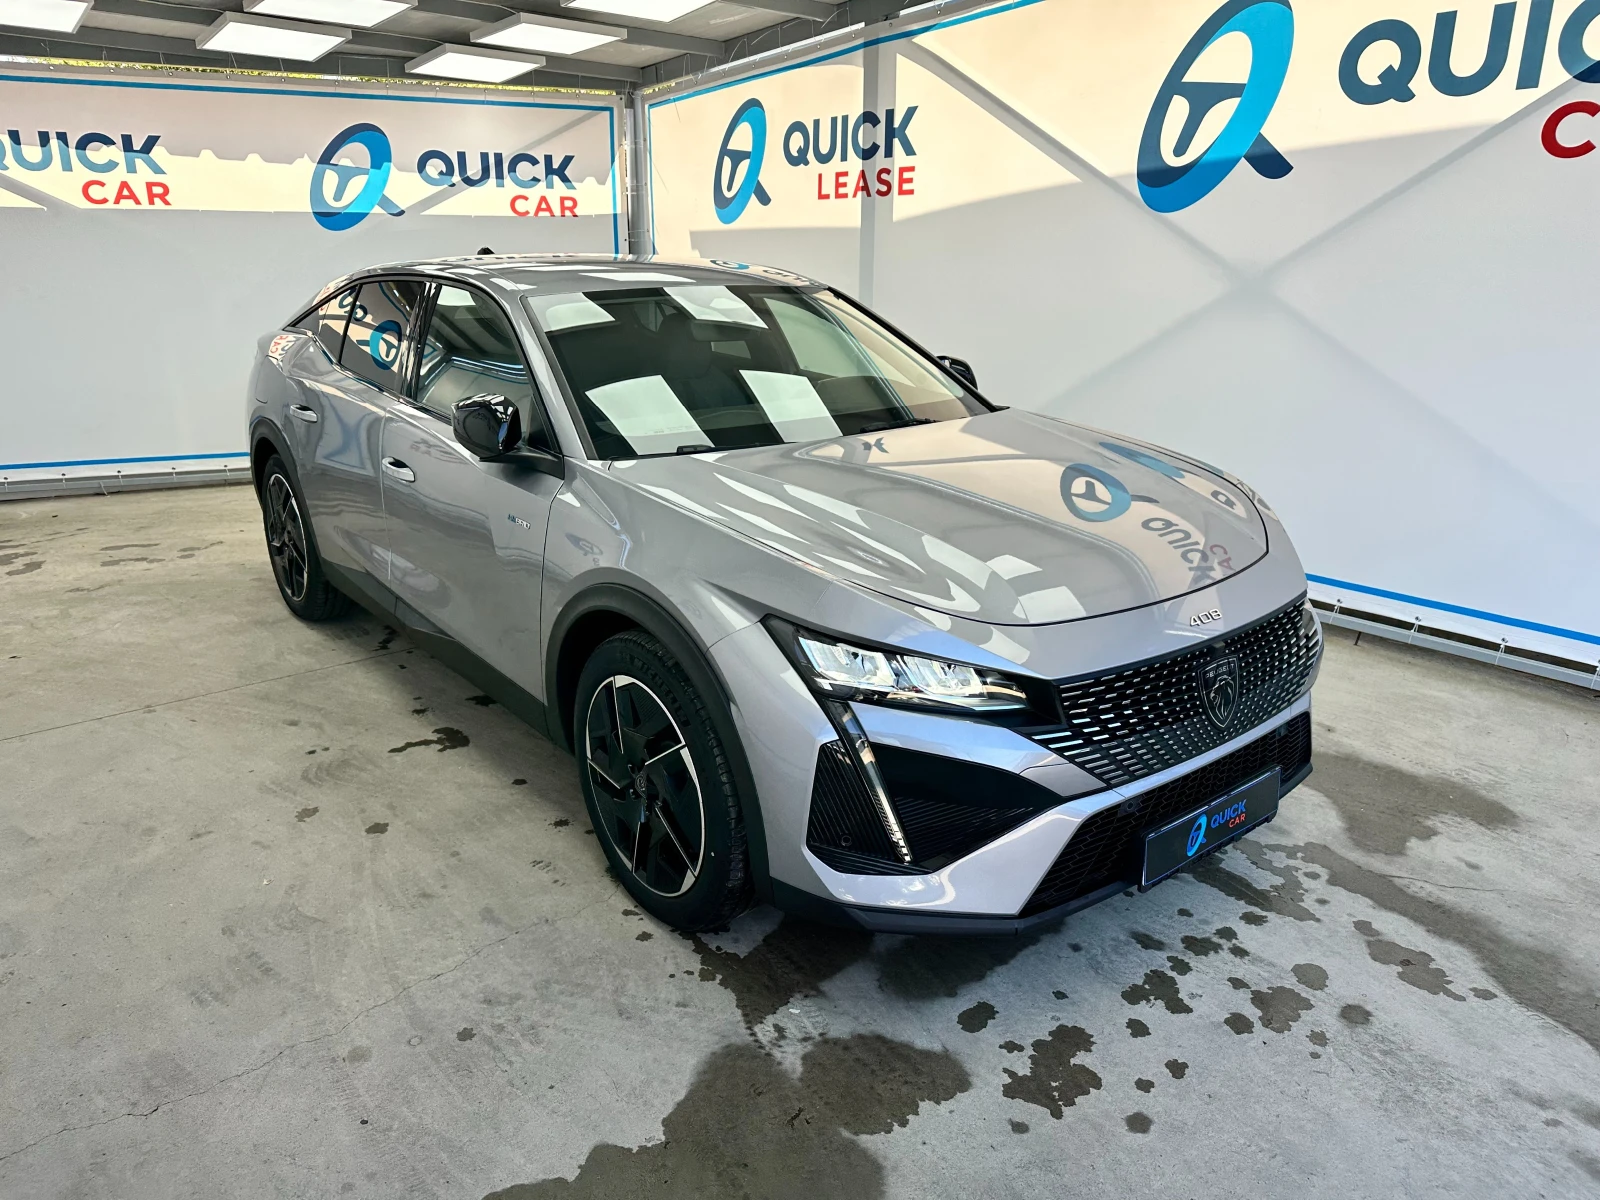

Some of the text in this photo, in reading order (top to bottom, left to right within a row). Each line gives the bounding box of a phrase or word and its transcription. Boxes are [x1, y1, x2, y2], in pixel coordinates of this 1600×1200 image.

[783, 105, 919, 167] QUICK
[416, 149, 577, 190] QUICK
[817, 165, 916, 200] LEASE
[82, 179, 172, 206] CAR
[509, 194, 579, 218] CAR
[1190, 608, 1222, 627] 408
[1211, 799, 1247, 828] QUICK
[1228, 813, 1246, 828] CAR
